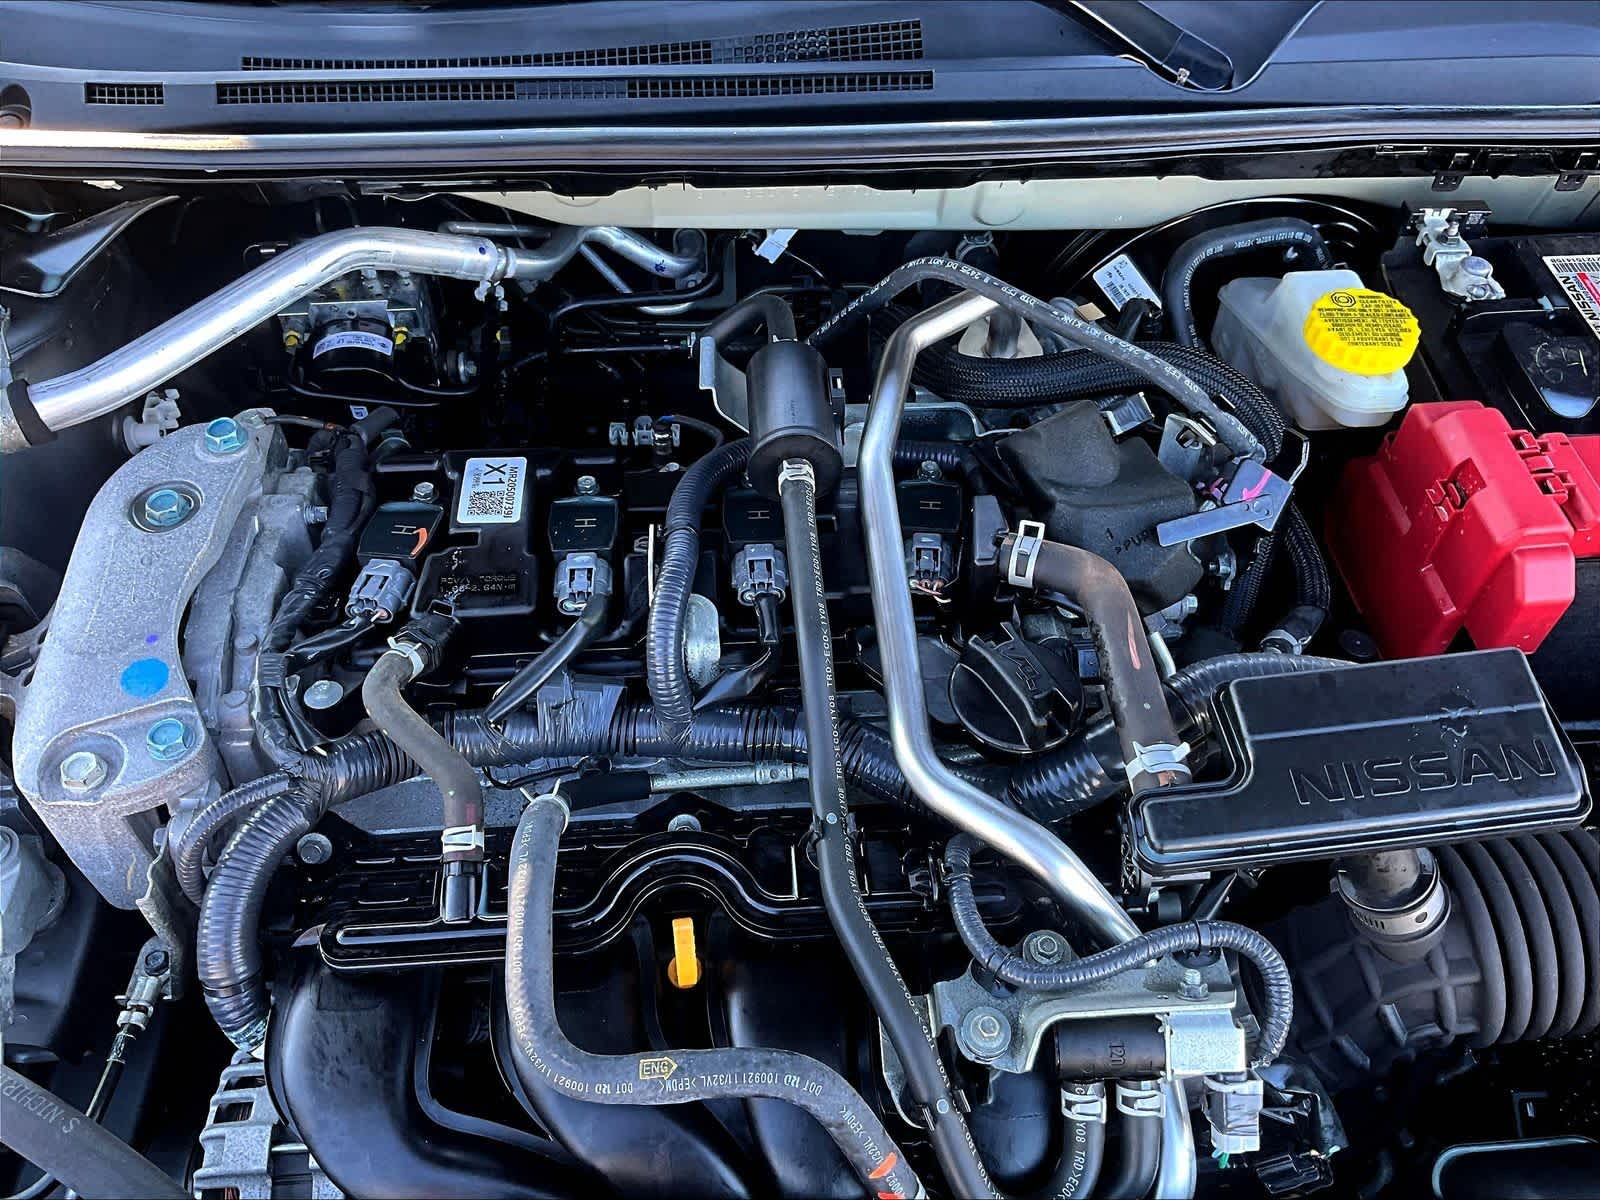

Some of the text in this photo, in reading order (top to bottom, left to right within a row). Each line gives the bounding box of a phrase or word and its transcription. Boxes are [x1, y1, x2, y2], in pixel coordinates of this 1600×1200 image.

[1558, 275, 1599, 323] NISSAN
[482, 463, 508, 485] X1
[1289, 738, 1557, 806] NISSAN
[642, 1060, 670, 1076] ENG
[743, 1072, 778, 1085] 100921
[616, 1081, 633, 1095] DOT
[803, 1079, 823, 1097] DOT
